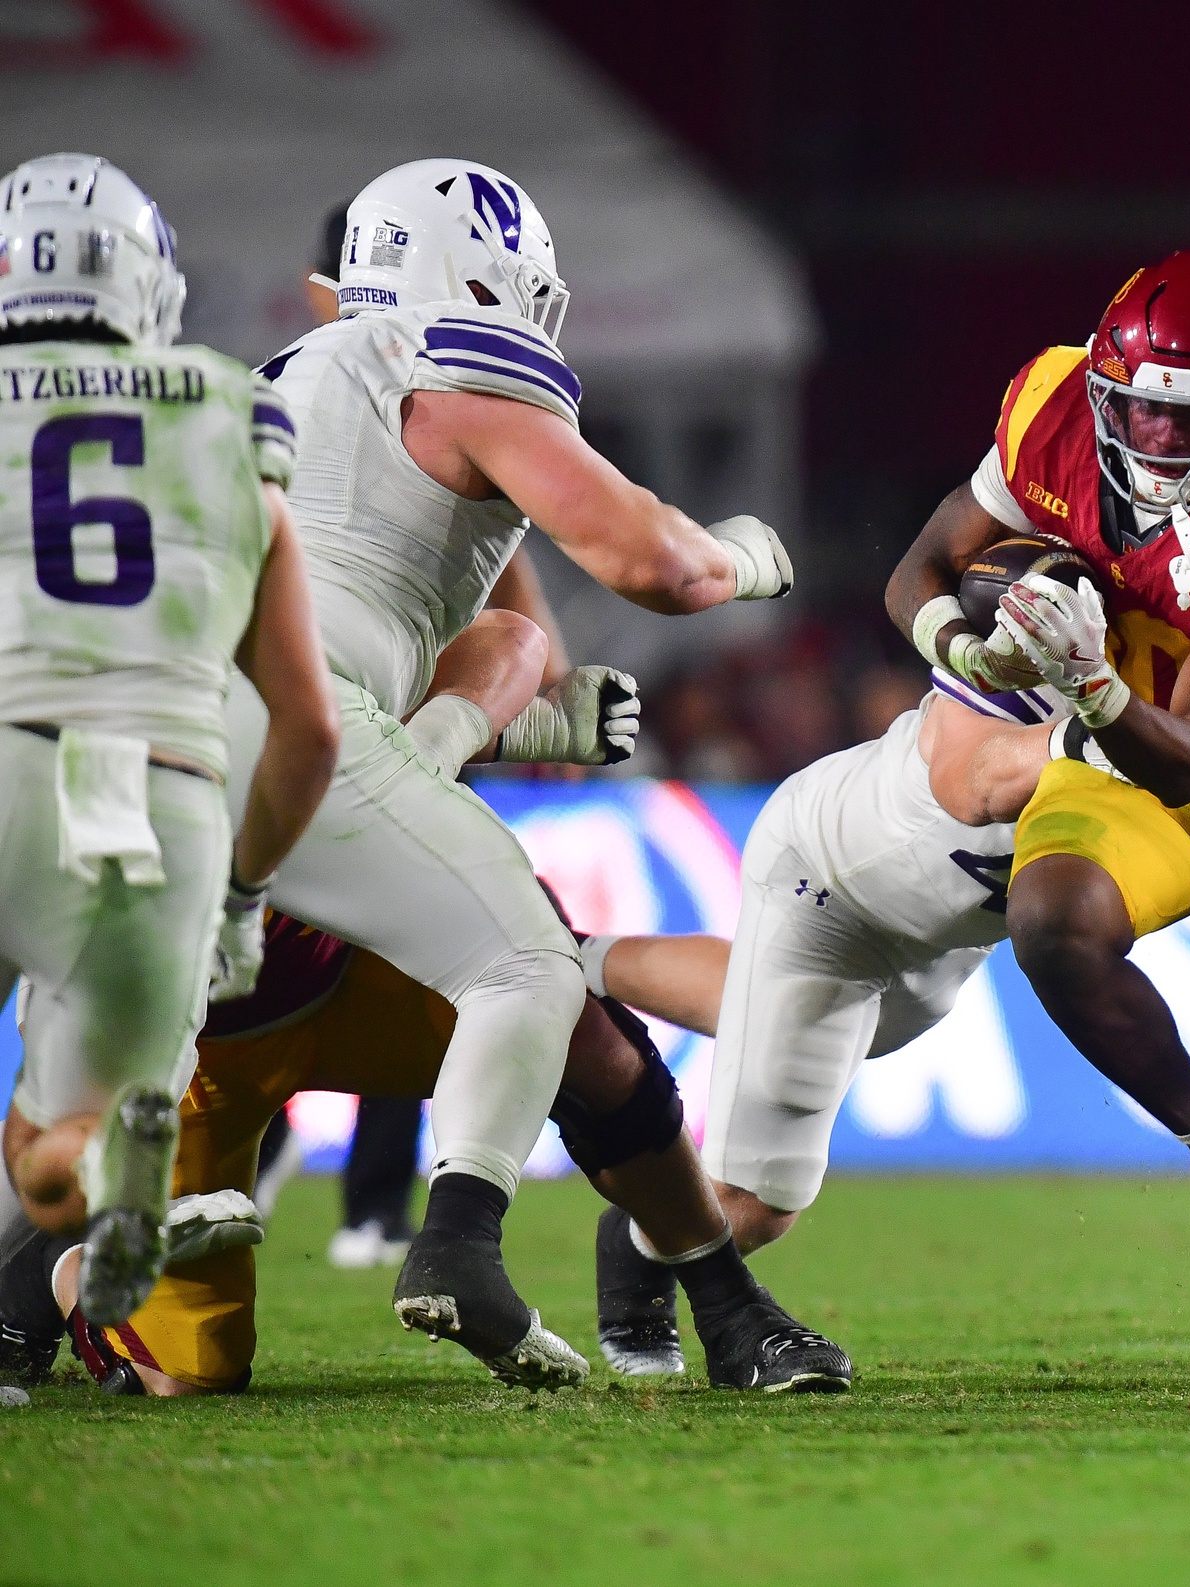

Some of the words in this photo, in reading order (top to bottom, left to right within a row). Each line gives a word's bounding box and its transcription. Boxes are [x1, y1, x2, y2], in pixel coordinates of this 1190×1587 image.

[466, 172, 521, 254] N
[33, 231, 55, 273] 6
[0, 365, 206, 402] TZGERALD
[31, 412, 155, 607] 6
